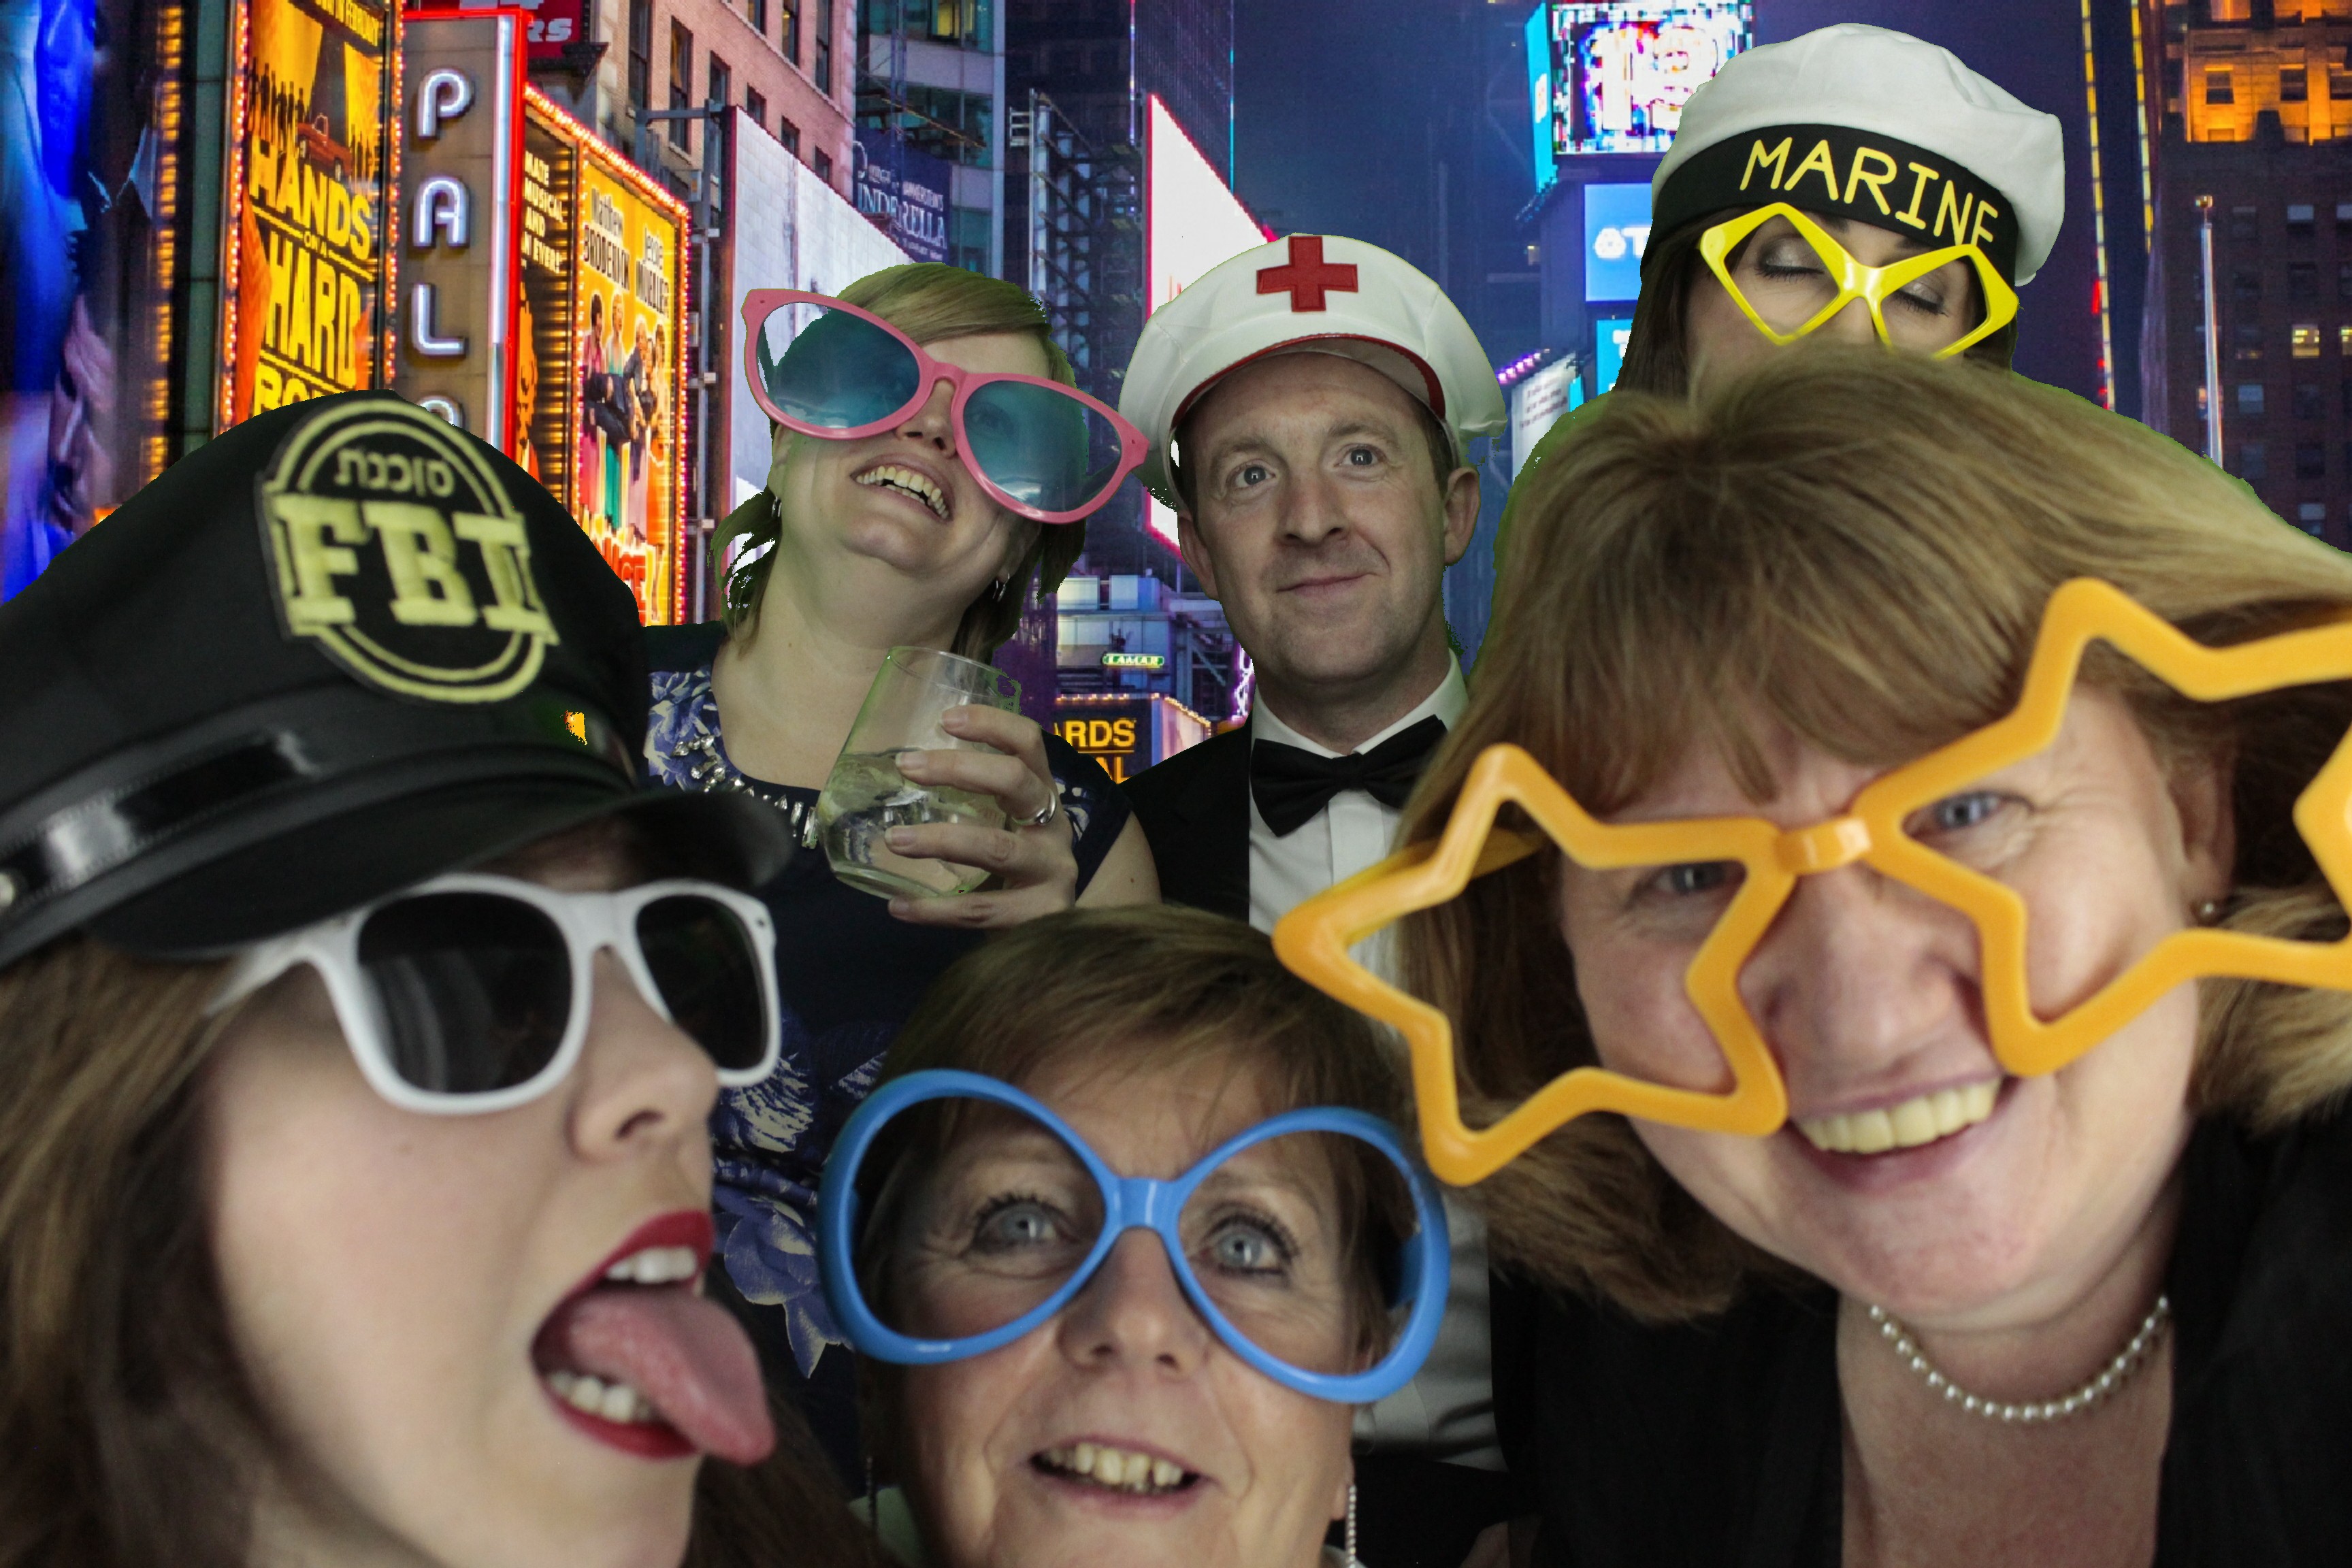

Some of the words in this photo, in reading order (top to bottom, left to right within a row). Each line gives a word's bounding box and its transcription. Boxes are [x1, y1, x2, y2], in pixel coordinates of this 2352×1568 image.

[249, 136, 372, 261] HANDS
[304, 231, 319, 252] ON
[1740, 137, 1998, 246] MARINE
[266, 230, 361, 389] HARD
[274, 494, 554, 634] FBI
[1108, 654, 1160, 666] LAMAR
